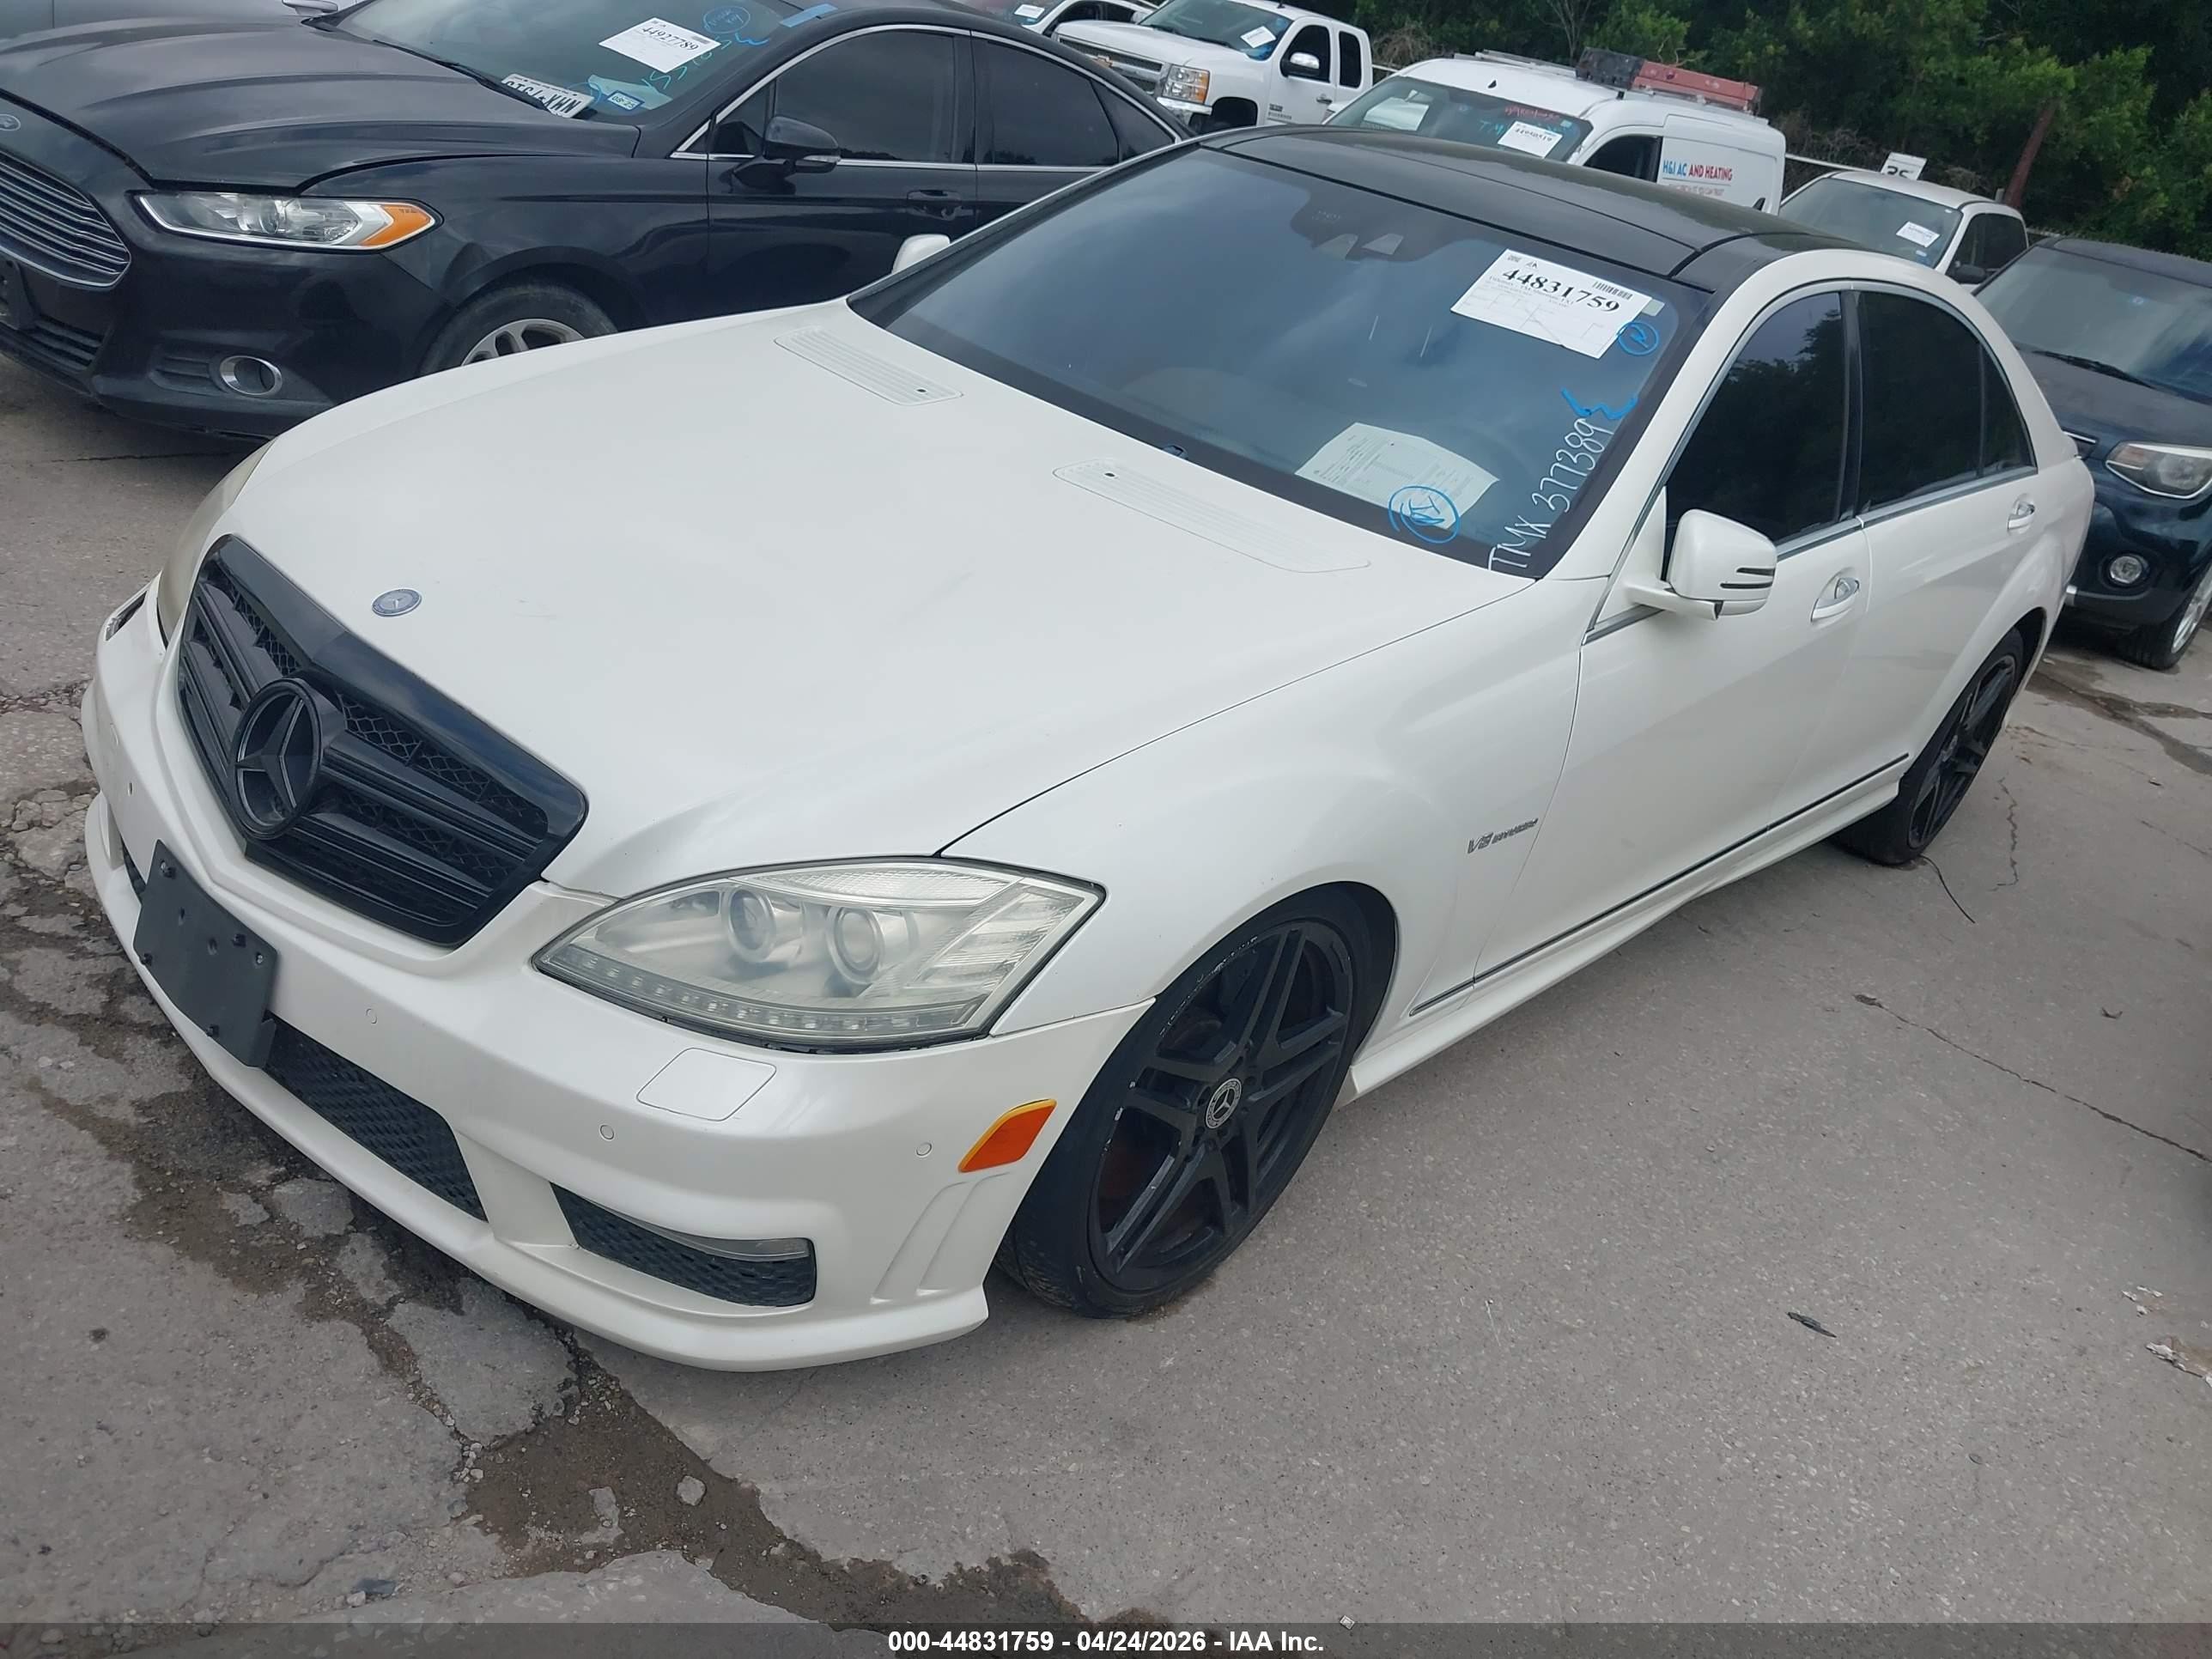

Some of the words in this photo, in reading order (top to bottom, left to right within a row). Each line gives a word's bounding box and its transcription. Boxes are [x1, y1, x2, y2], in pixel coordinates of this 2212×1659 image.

[641, 27, 699, 51] 44927789
[1676, 162, 1687, 177] AC
[1688, 163, 1704, 178] AND
[1705, 165, 1733, 181] HEATING
[1502, 269, 1620, 313] 44831759
[1531, 418, 1615, 514] 377389
